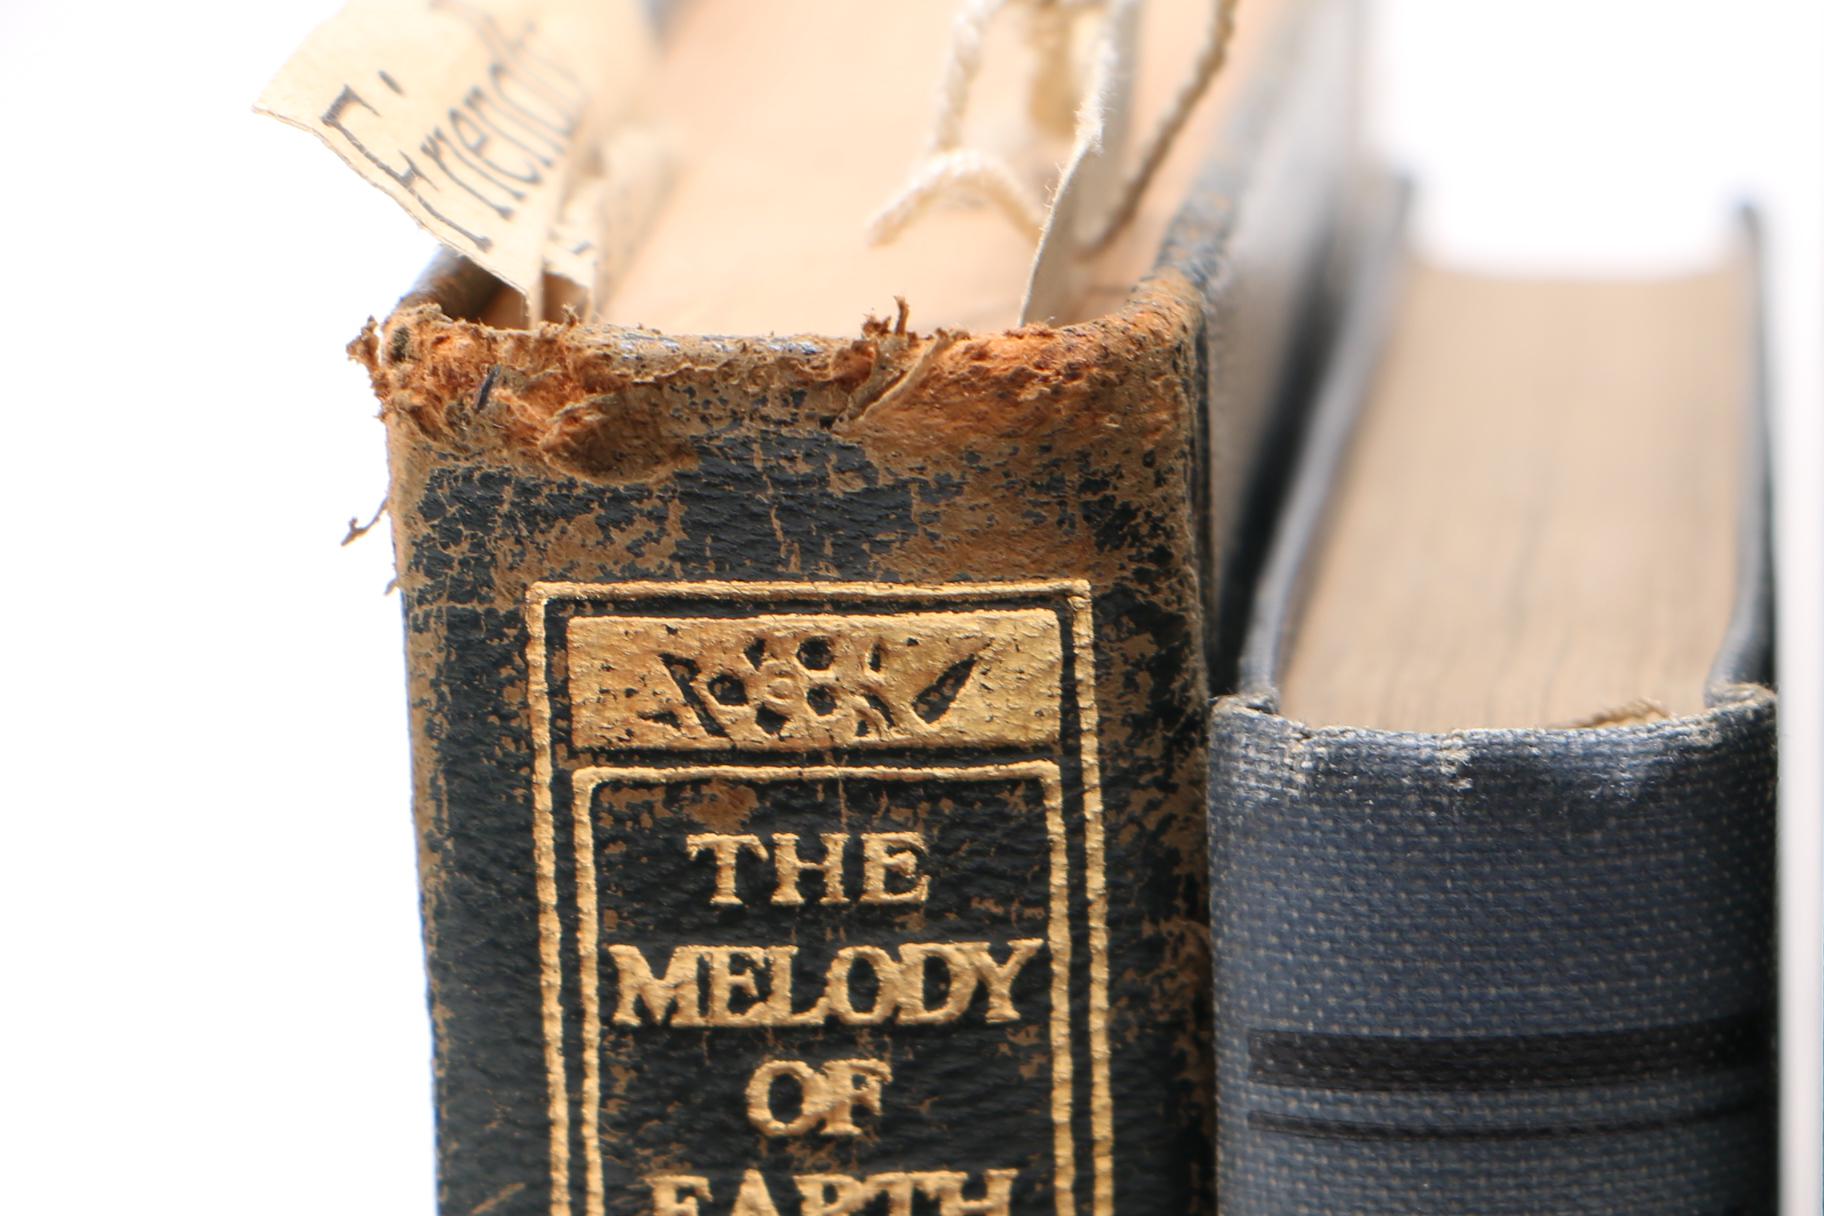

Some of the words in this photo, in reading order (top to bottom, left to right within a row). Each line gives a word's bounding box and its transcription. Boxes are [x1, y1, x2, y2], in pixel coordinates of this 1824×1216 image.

[686, 831, 930, 906] THE
[608, 938, 1044, 1028] MELODY
[745, 1058, 893, 1137] OF
